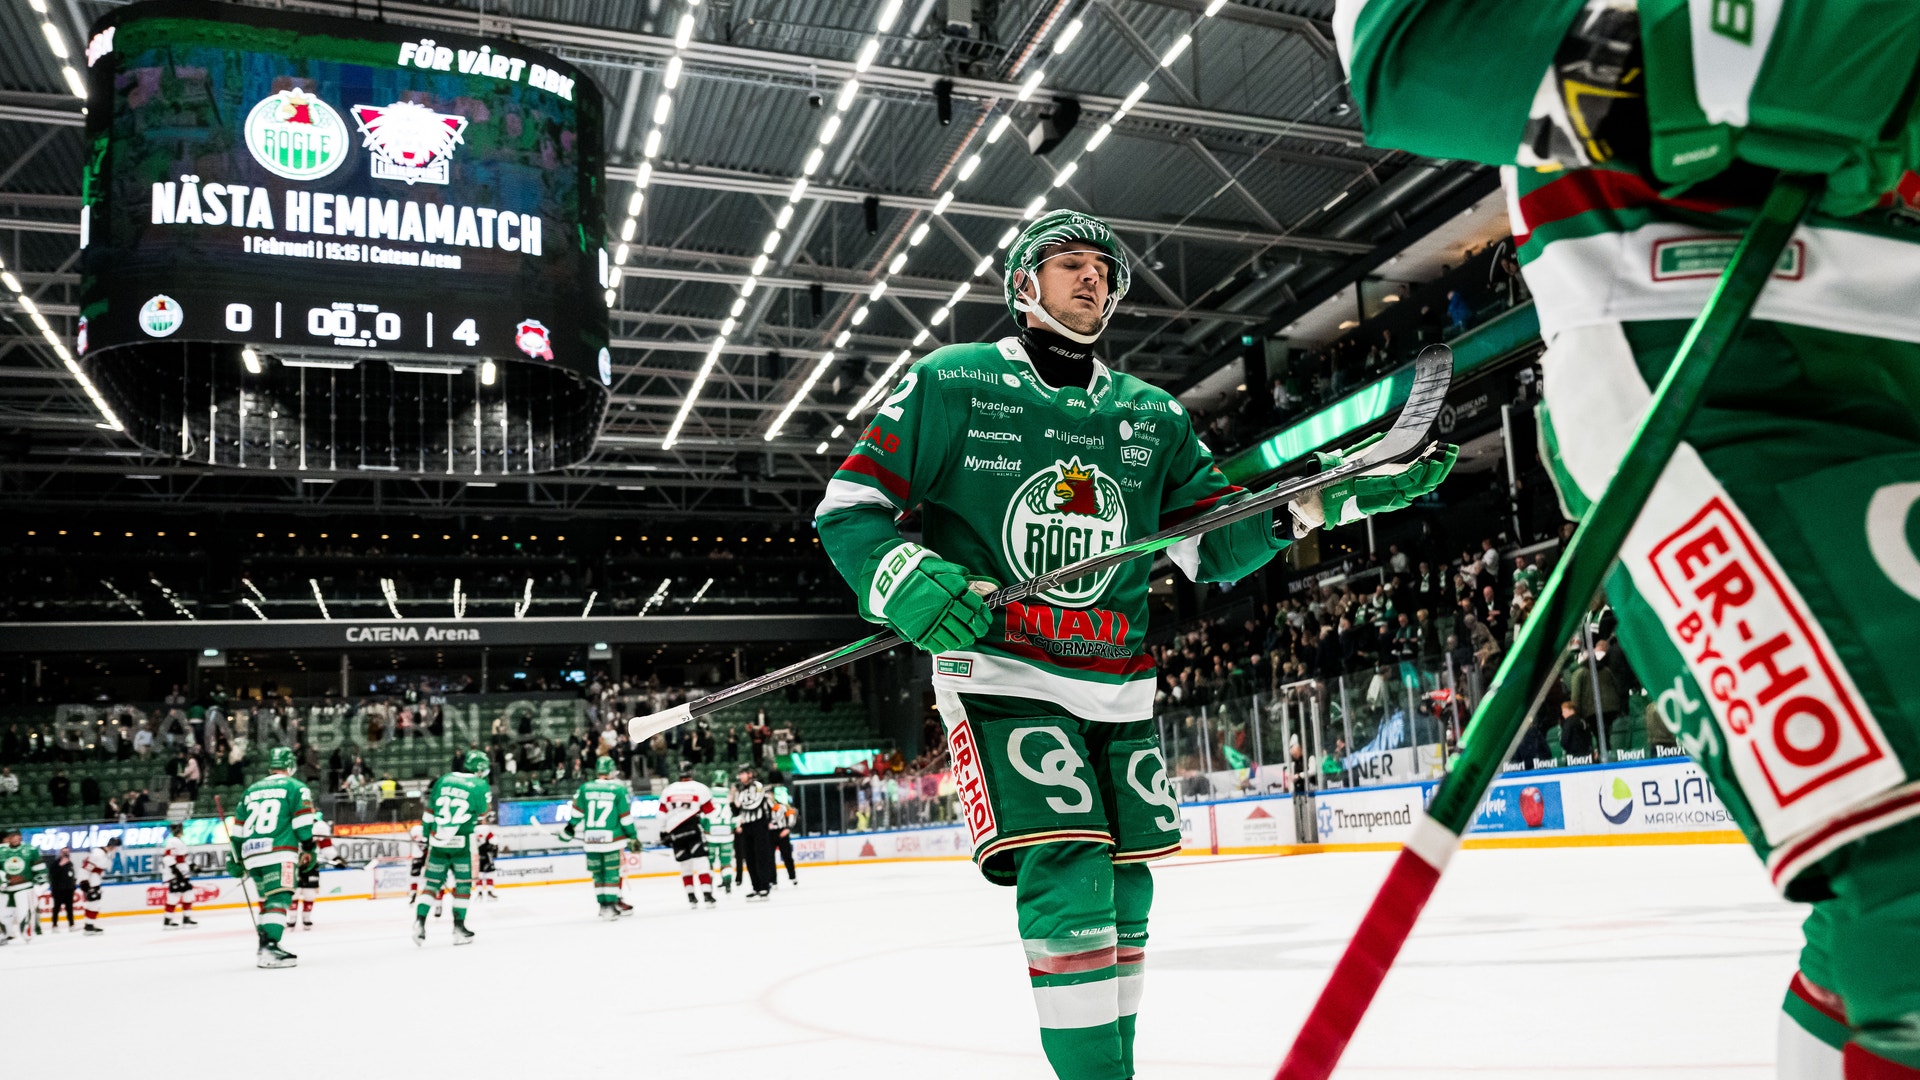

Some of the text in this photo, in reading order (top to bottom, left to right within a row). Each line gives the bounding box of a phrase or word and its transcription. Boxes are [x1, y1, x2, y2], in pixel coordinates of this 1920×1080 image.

[398, 38, 575, 102] FÖR VÅRT RBK
[263, 127, 332, 158] RÖGLE
[151, 174, 542, 257] NÄSTA HEMMAMATCH
[242, 235, 462, 270] 1 Februari 15:15 Catena Arena
[225, 303, 253, 332] 0
[307, 307, 401, 341] 00.0
[452, 318, 480, 346] 4
[937, 366, 999, 385] Backahill
[877, 371, 918, 422] 2
[971, 397, 1023, 414] Bevaclean
[1066, 398, 1087, 408] SHL
[967, 429, 1022, 442] MARCON
[1025, 518, 1114, 576] RÖGLE
[346, 626, 480, 642] CATENA Arena
[1005, 600, 1130, 647] MAXI
[1034, 637, 1132, 659] STORMARKNAD
[1675, 526, 1841, 768] ER-HO
[760, 673, 804, 693] NEXUS
[1676, 611, 1754, 736] BYGG
[1533, 758, 1558, 769] Boozt
[1566, 754, 1593, 766] Boozt
[1617, 748, 1645, 761] Boozt
[953, 731, 986, 830] ER-HO
[1641, 770, 1713, 807] BJÄ
[243, 799, 281, 838] 28
[435, 796, 472, 825] 32
[586, 800, 615, 828] 17
[1335, 804, 1412, 833] Tranpenad
